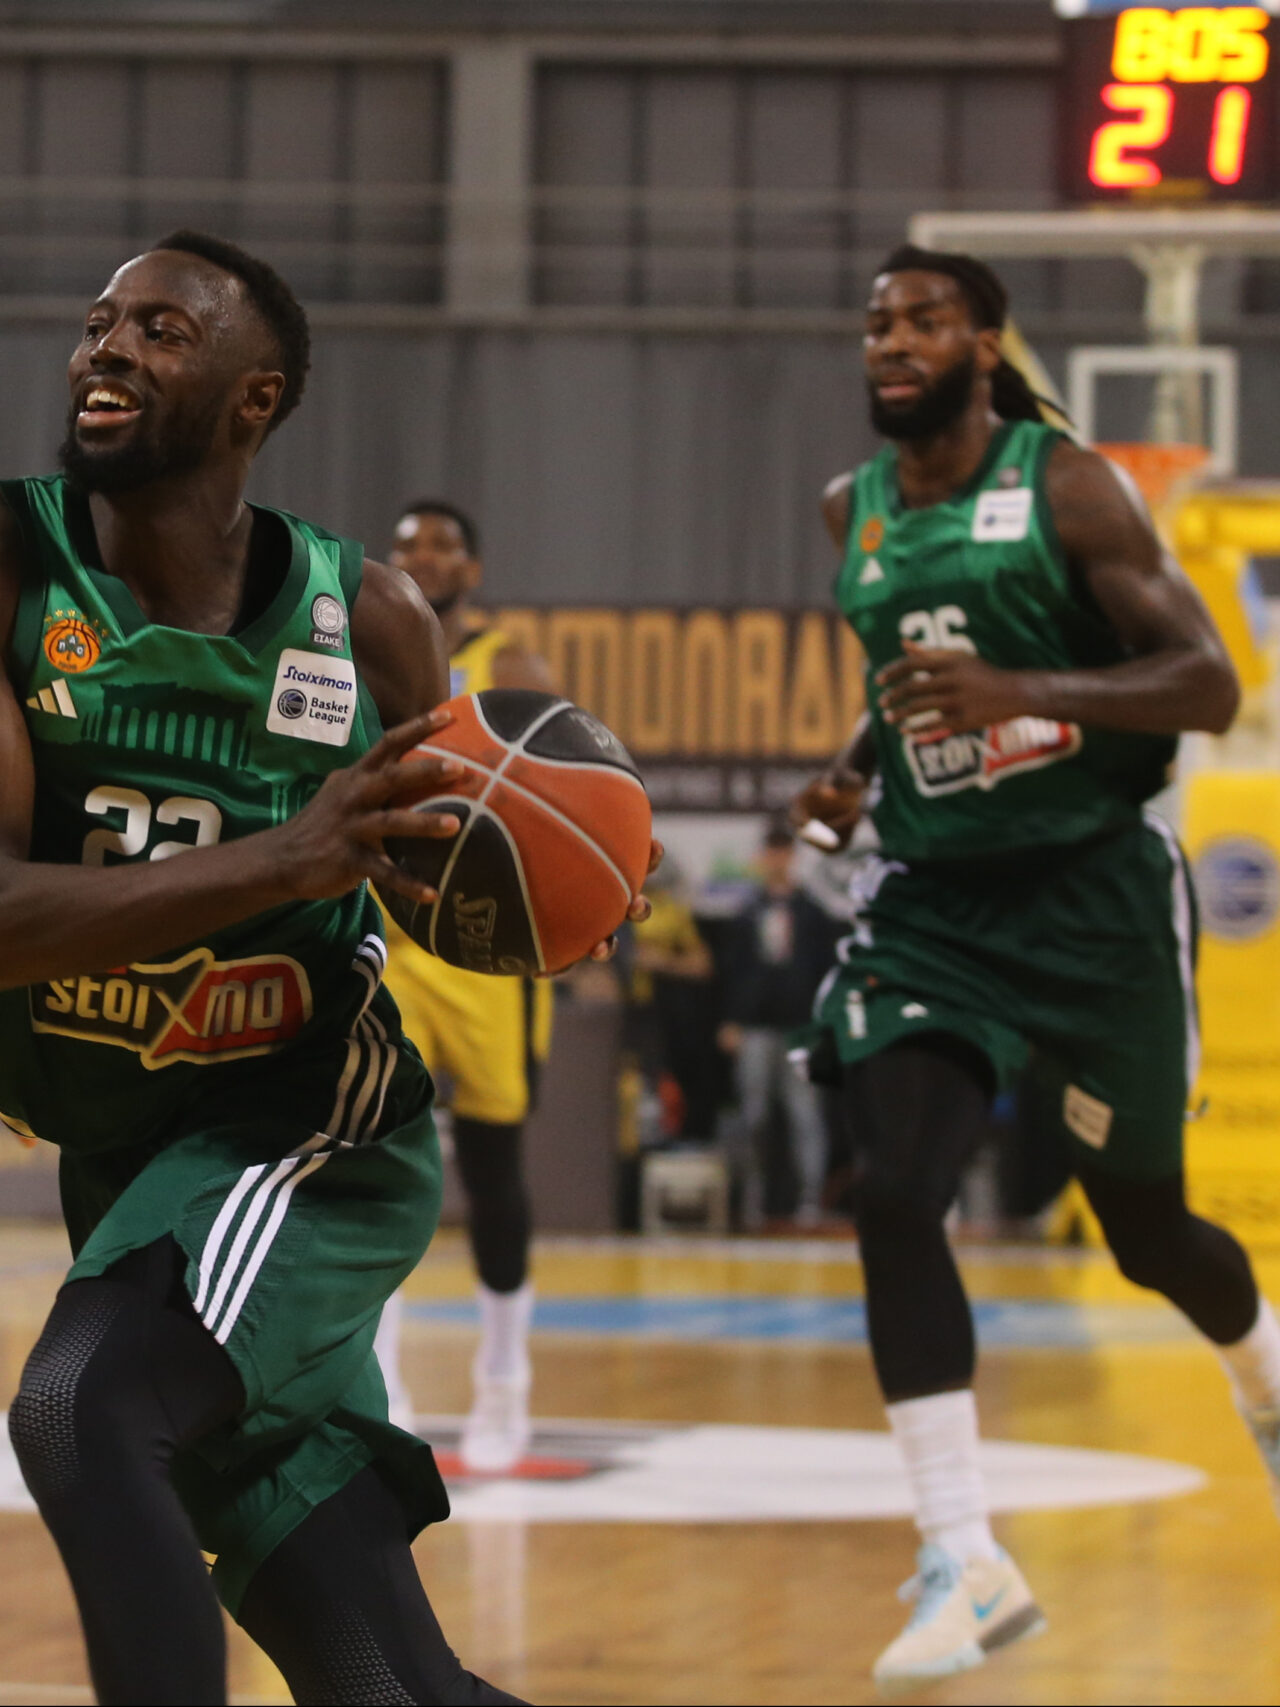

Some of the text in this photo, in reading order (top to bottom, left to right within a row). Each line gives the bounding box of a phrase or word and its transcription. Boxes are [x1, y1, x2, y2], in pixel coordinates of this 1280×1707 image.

[1088, 83, 1251, 187] 21
[283, 665, 353, 692] Stoiximan
[311, 696, 349, 714] Basket
[308, 708, 347, 725] League
